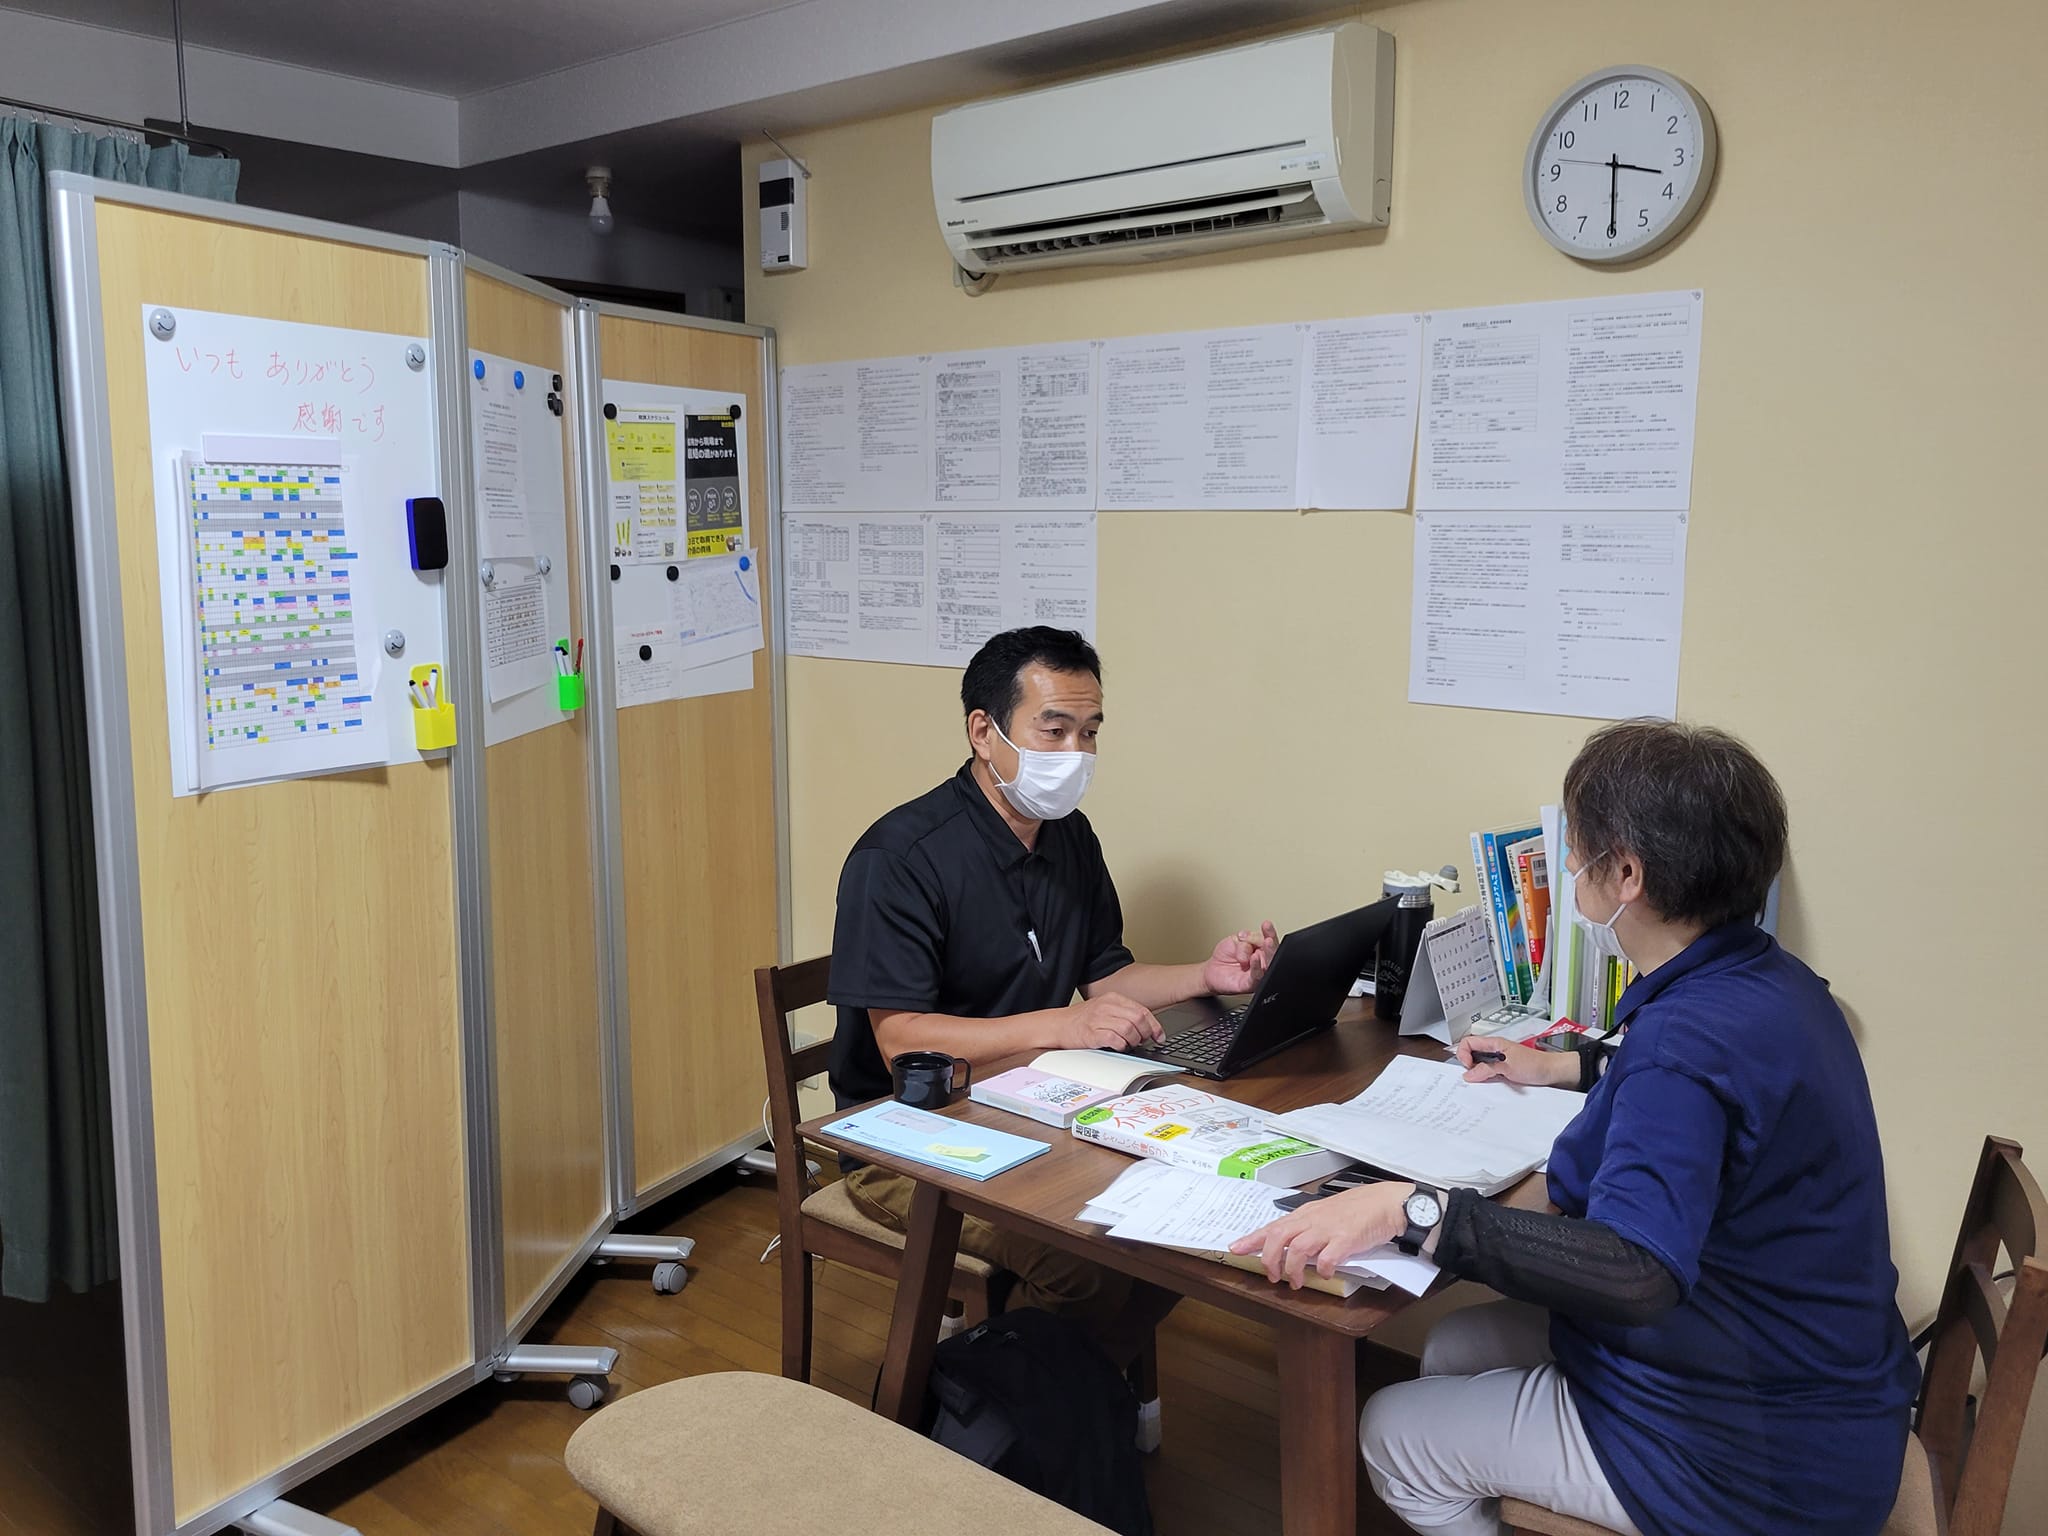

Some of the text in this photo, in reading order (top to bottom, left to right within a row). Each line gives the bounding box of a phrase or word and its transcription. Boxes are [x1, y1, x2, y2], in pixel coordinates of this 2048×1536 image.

[1614, 90, 1629, 109] 12
[1584, 103, 1598, 122] 11
[1667, 116, 1678, 134] 2
[1559, 131, 1574, 149] 10
[1673, 149, 1684, 166] 3
[1551, 165, 1560, 181] 9
[1662, 183, 1673, 200] 4
[1556, 195, 1567, 212] 8
[1577, 216, 1587, 233] 7
[1638, 209, 1648, 227] 5
[176, 347, 375, 394] いつも ありがとう
[292, 401, 385, 442] 感謝です
[1113, 1094, 1216, 1130] 介護のコツ
